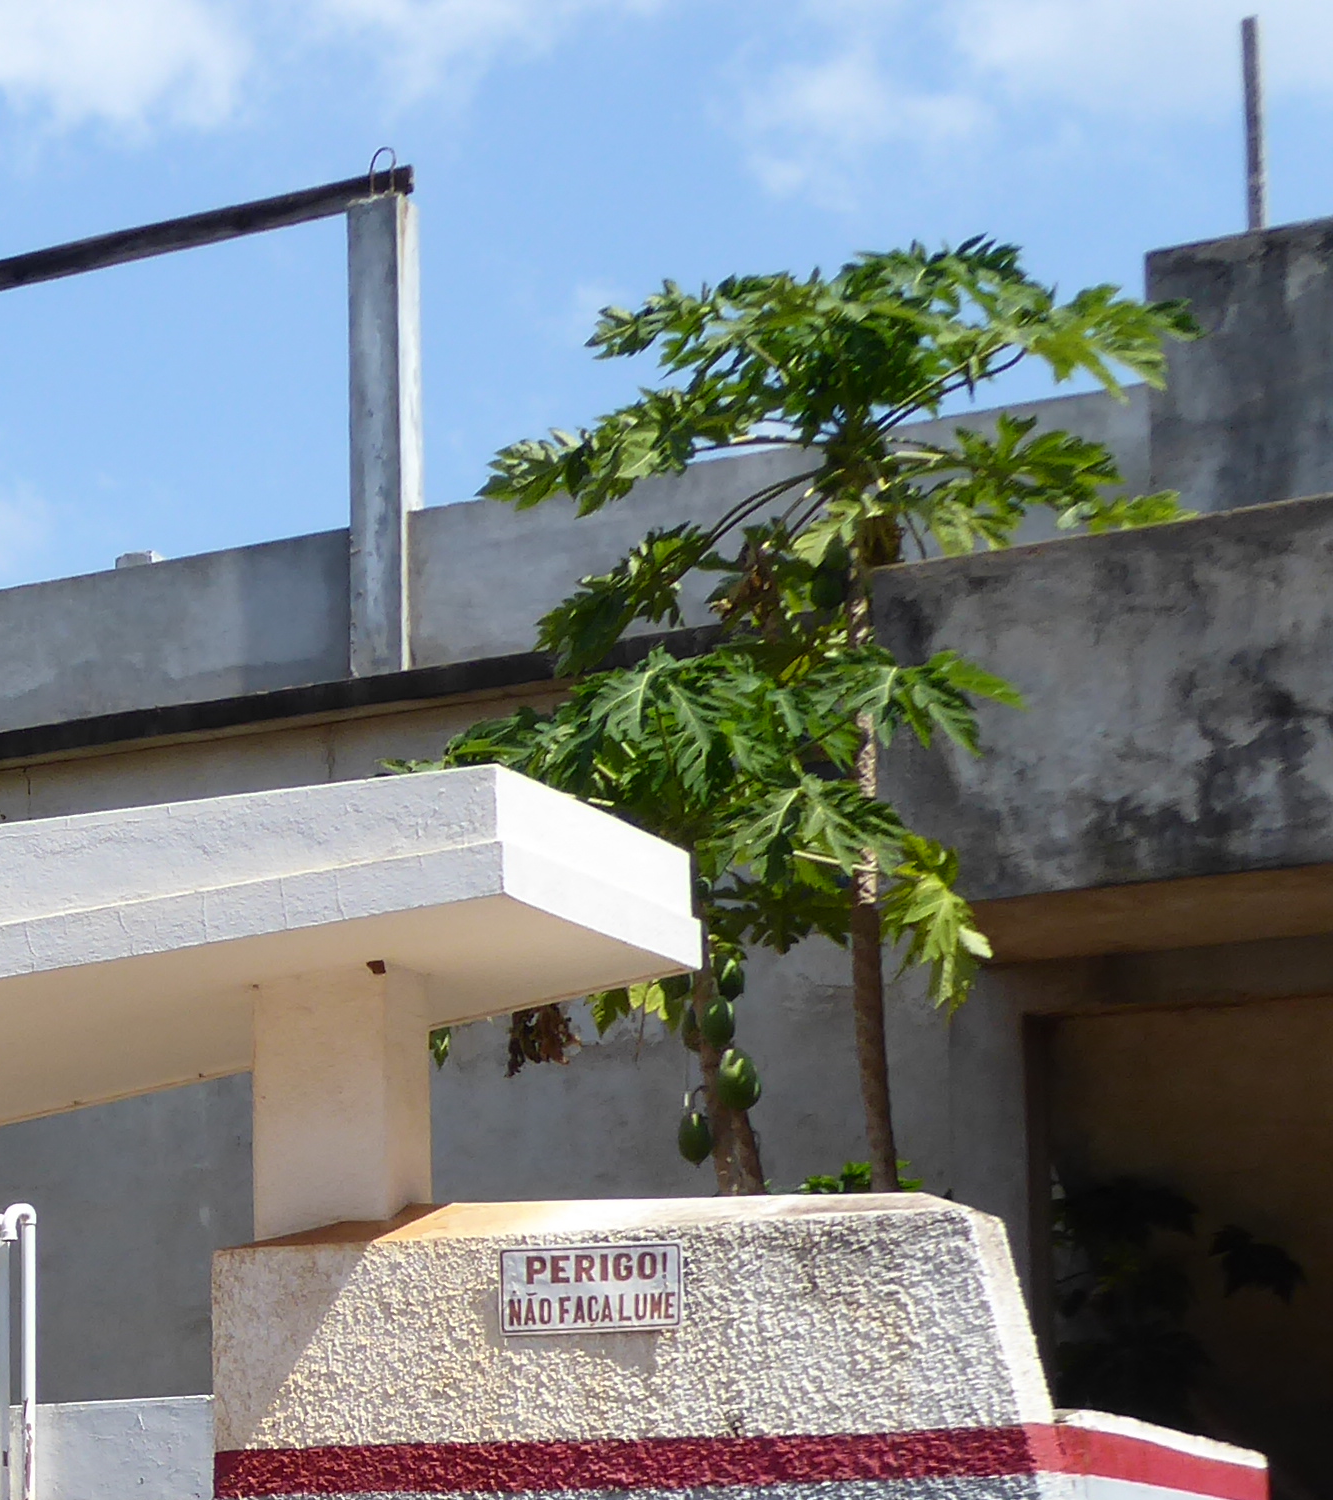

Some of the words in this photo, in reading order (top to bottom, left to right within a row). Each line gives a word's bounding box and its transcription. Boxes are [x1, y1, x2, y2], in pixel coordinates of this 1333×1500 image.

[525, 1251, 668, 1285] PERIGO!
[508, 1290, 552, 1327] NÃO
[617, 1291, 676, 1322] LUME
